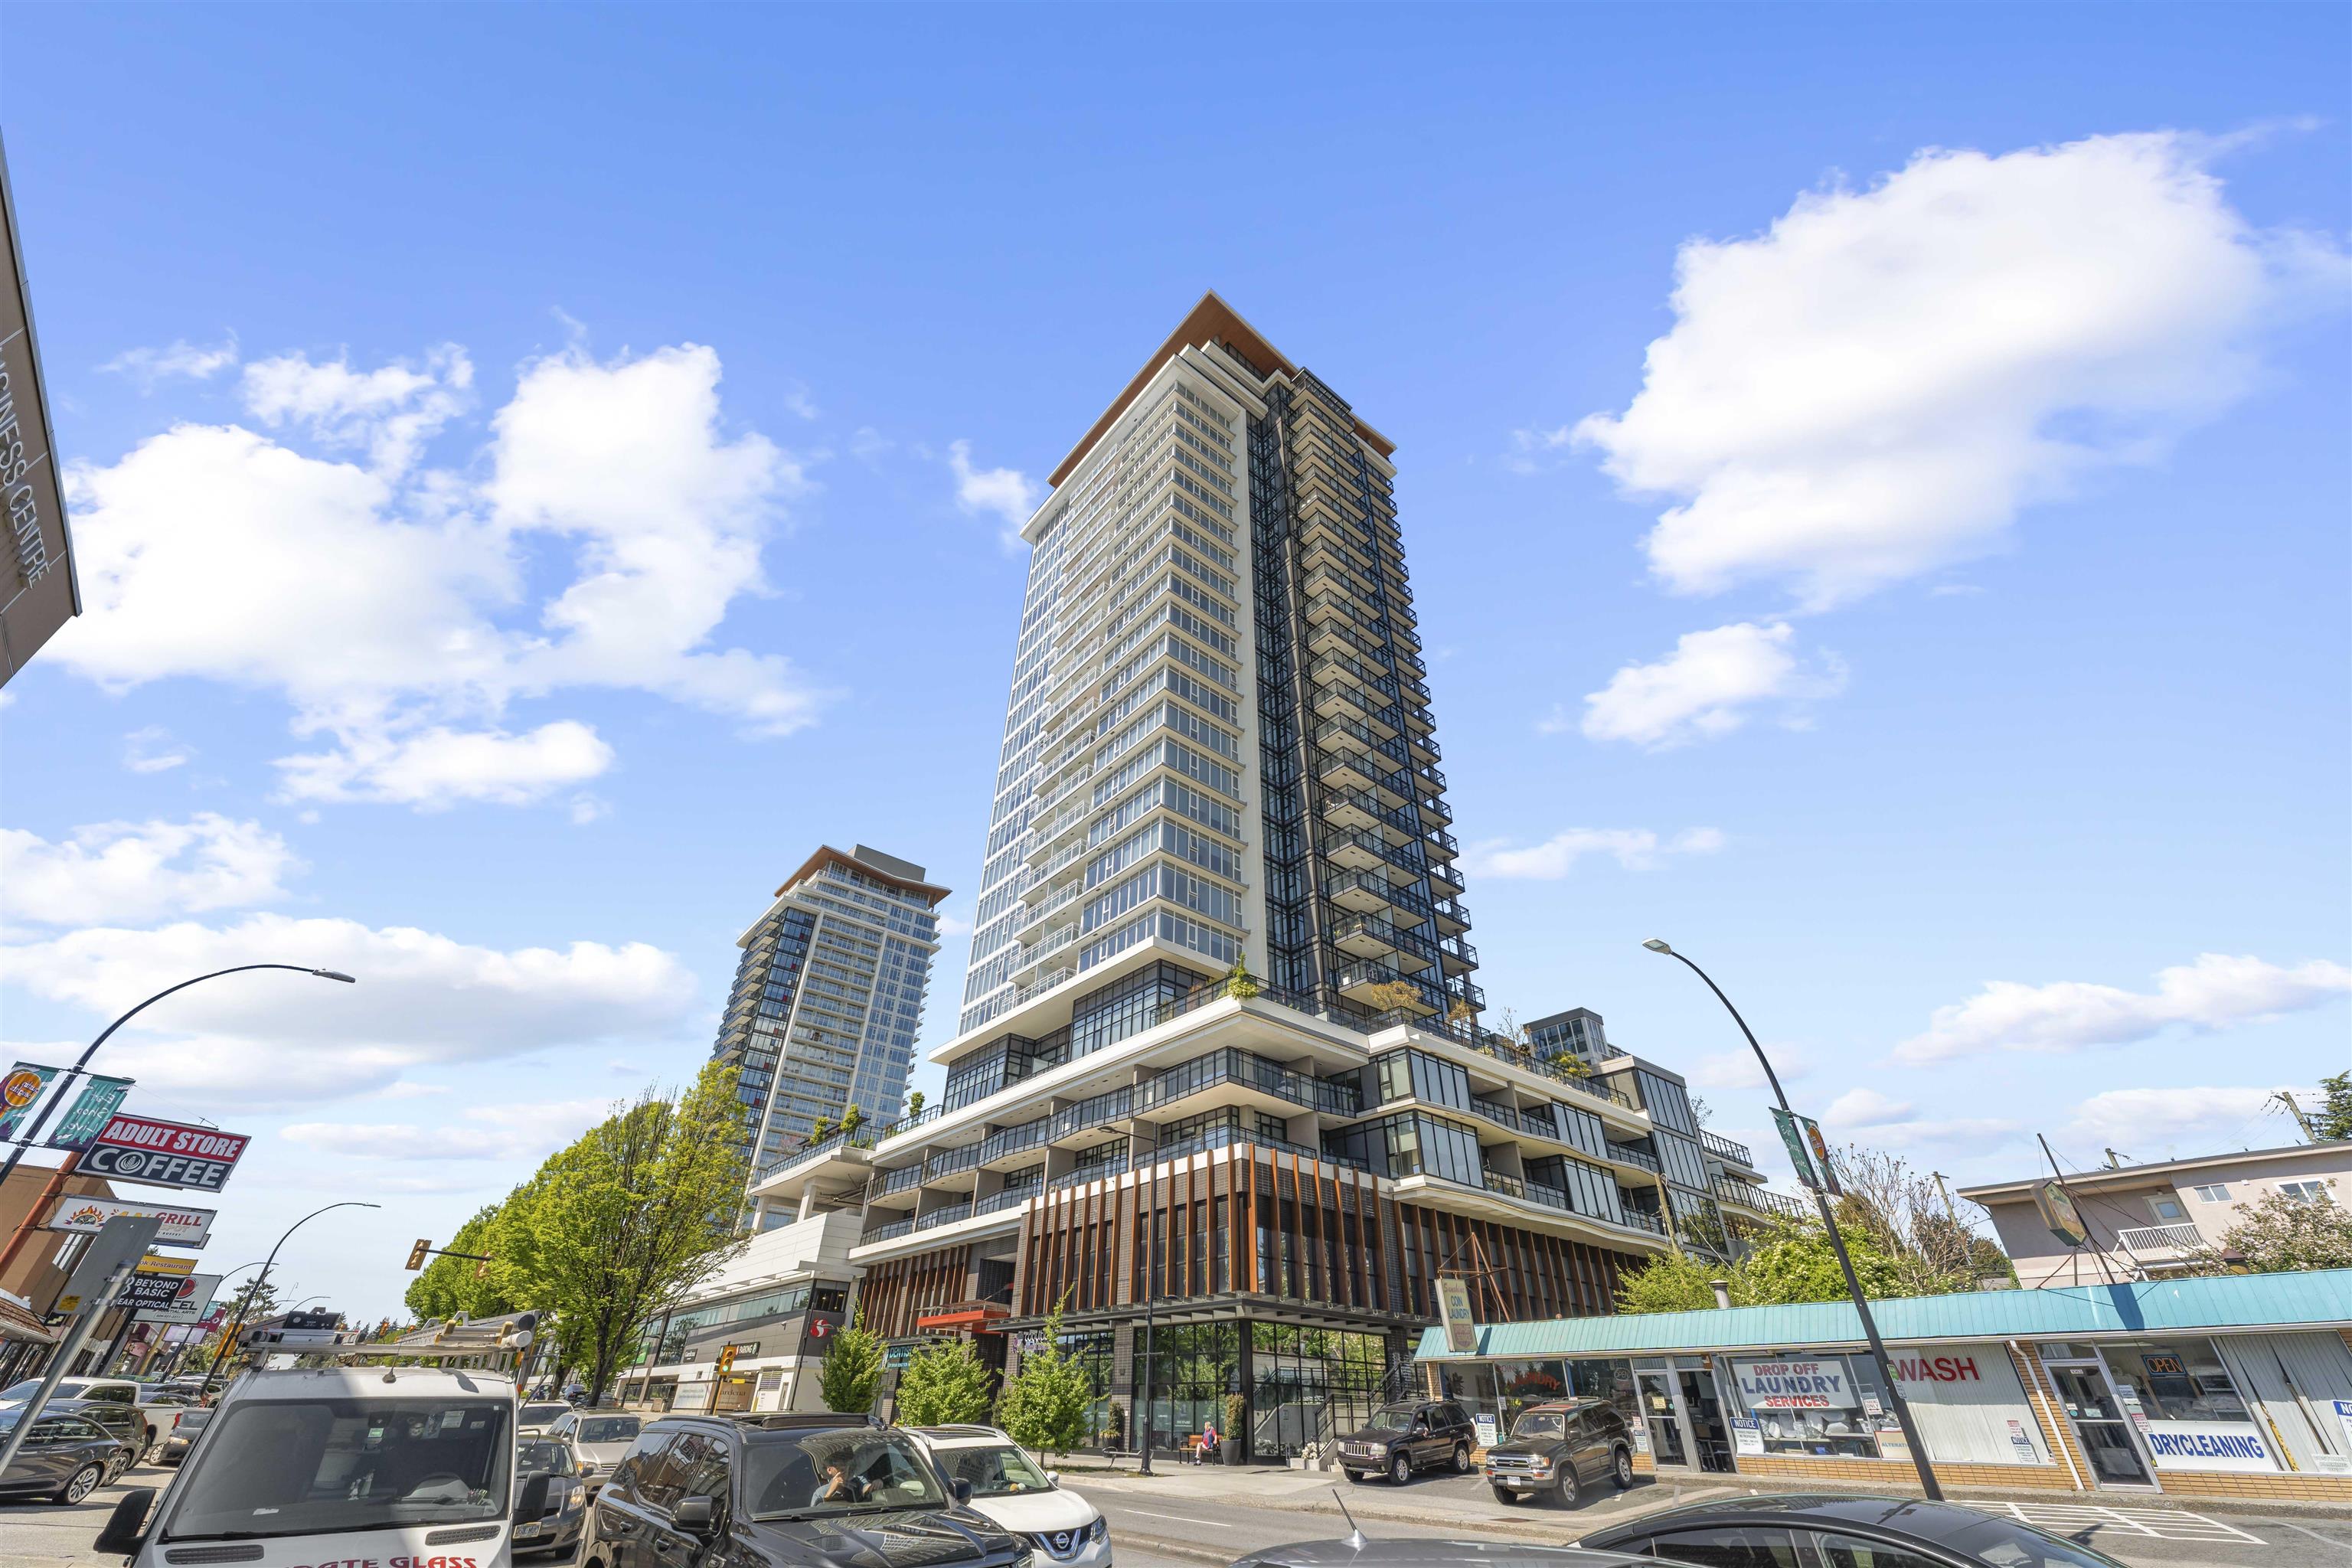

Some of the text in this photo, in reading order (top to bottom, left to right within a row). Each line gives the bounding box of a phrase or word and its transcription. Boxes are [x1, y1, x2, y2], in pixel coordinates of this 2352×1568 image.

[10, 485, 50, 589] CENTRE
[103, 1121, 243, 1158] ADULT STORE
[91, 1148, 225, 1186] COFFEE
[155, 1211, 202, 1227] GRILL
[151, 1261, 192, 1270] Restaurant
[135, 1279, 178, 1290] BEYOND
[134, 1287, 170, 1298] BASIC
[117, 1298, 169, 1309] EAR OPTICAL
[1450, 1295, 1463, 1307] COIN
[1448, 1308, 1470, 1319] LAUNDRY
[738, 1343, 753, 1354] PARKING
[1753, 1363, 1819, 1376] DROP OFF
[1889, 1357, 1981, 1382] WASH
[2146, 1357, 2184, 1373] OPEN
[1741, 1375, 1841, 1394] LAUNDRY
[1764, 1395, 1830, 1407] SERVICES
[1734, 1419, 1756, 1428] NOTICE
[2148, 1433, 2265, 1459] DRYCLEANING
[389, 1557, 477, 1568] GLASS
